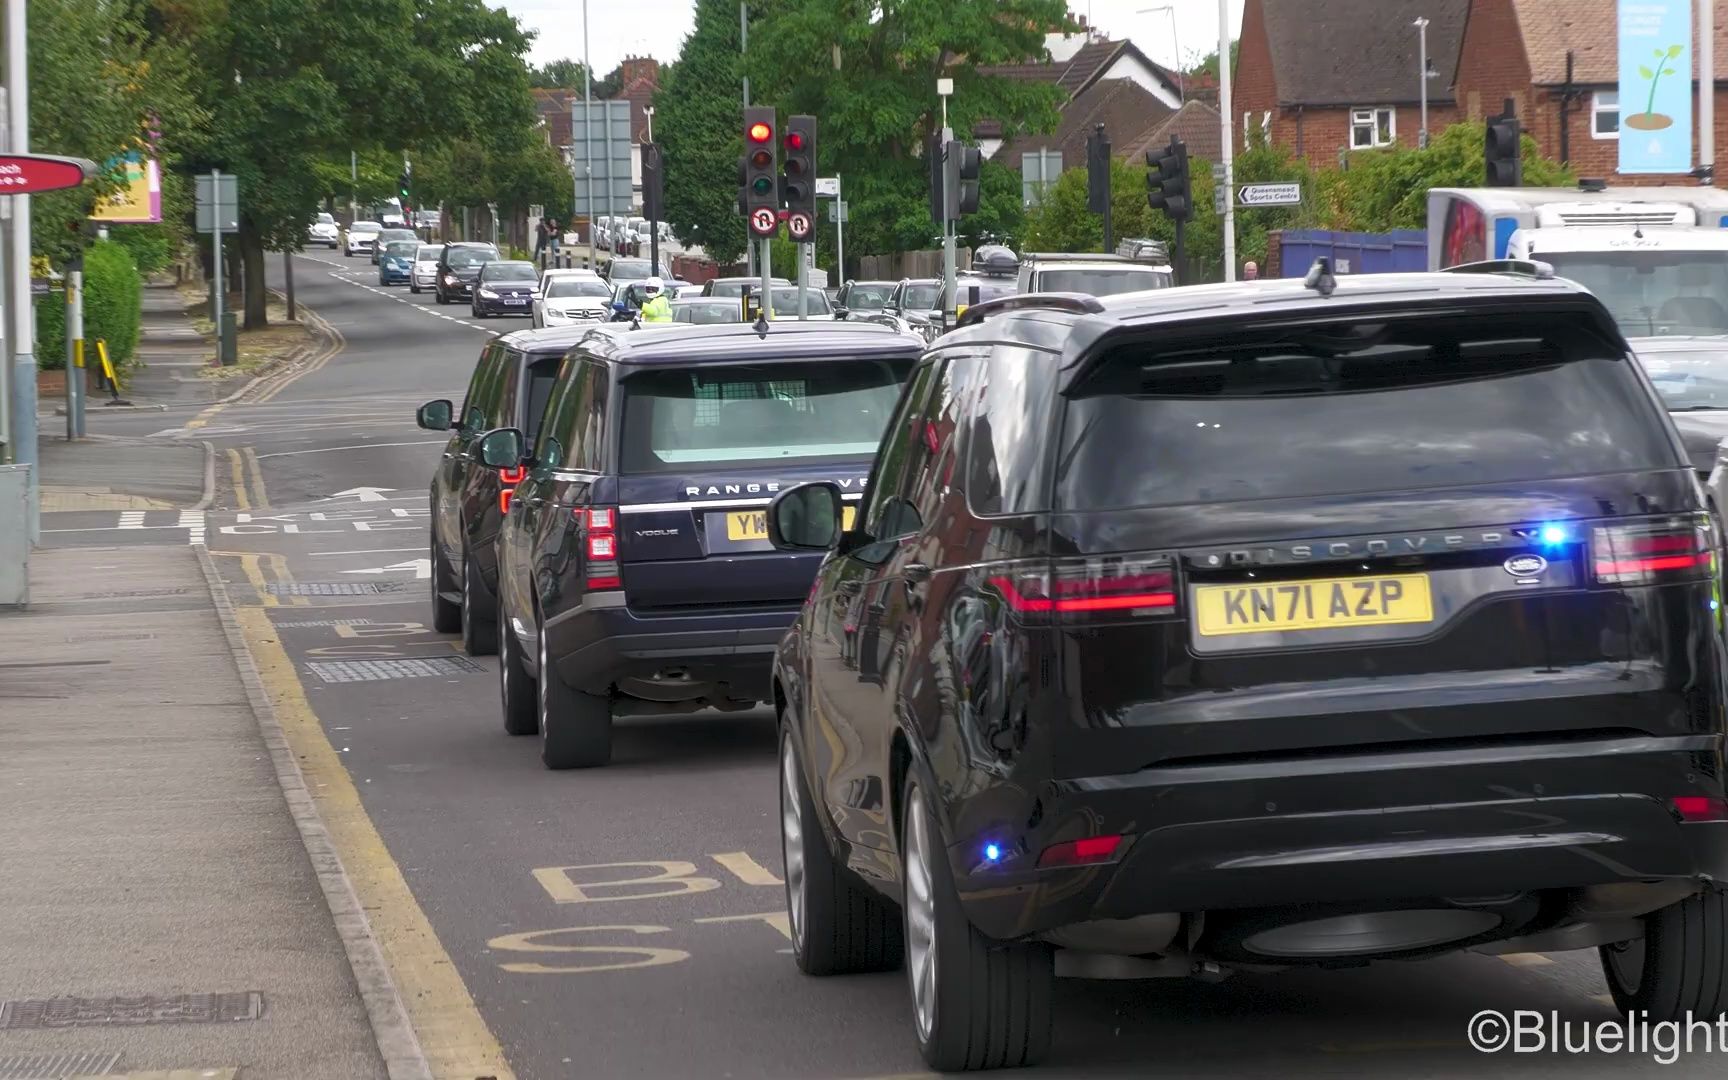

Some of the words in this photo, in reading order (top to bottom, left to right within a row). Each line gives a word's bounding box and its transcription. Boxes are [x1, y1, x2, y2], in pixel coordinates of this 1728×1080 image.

[686, 482, 780, 496] RANGE
[237, 508, 431, 523] KEE
[635, 528, 679, 537] VOGUE
[1230, 530, 1539, 565] DISCOVERY
[1223, 585, 1315, 625] KN71
[1328, 579, 1404, 618] AZP
